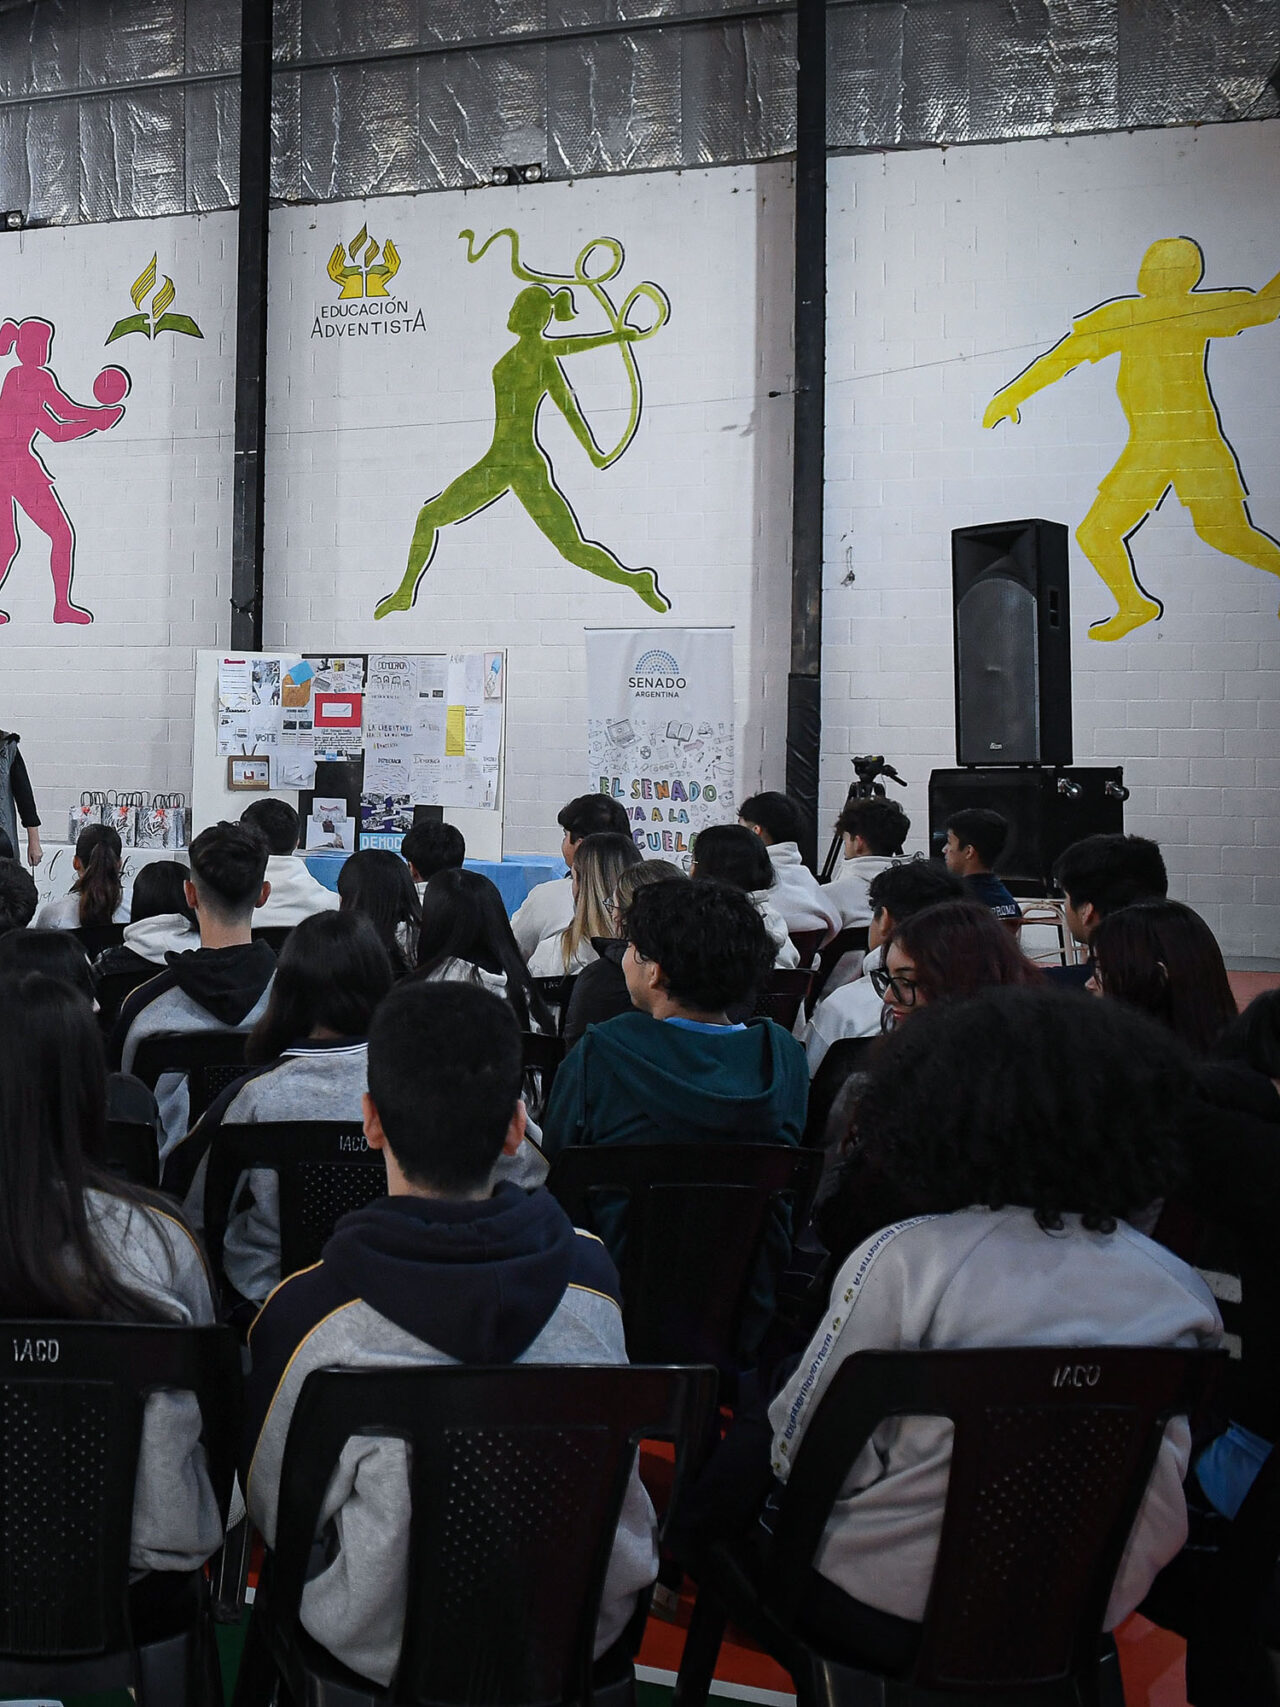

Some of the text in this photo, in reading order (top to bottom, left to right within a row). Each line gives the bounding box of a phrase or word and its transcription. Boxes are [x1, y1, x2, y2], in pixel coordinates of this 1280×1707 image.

[321, 296, 408, 318] EDUCACIÓN
[311, 308, 426, 339] ADVENTISTA
[628, 677, 687, 689] SENADO
[599, 776, 717, 802] EL SENADO
[651, 807, 663, 822] A
[668, 808, 690, 823] LA
[362, 836, 402, 850] DEMOC
[632, 828, 699, 853] CUEL
